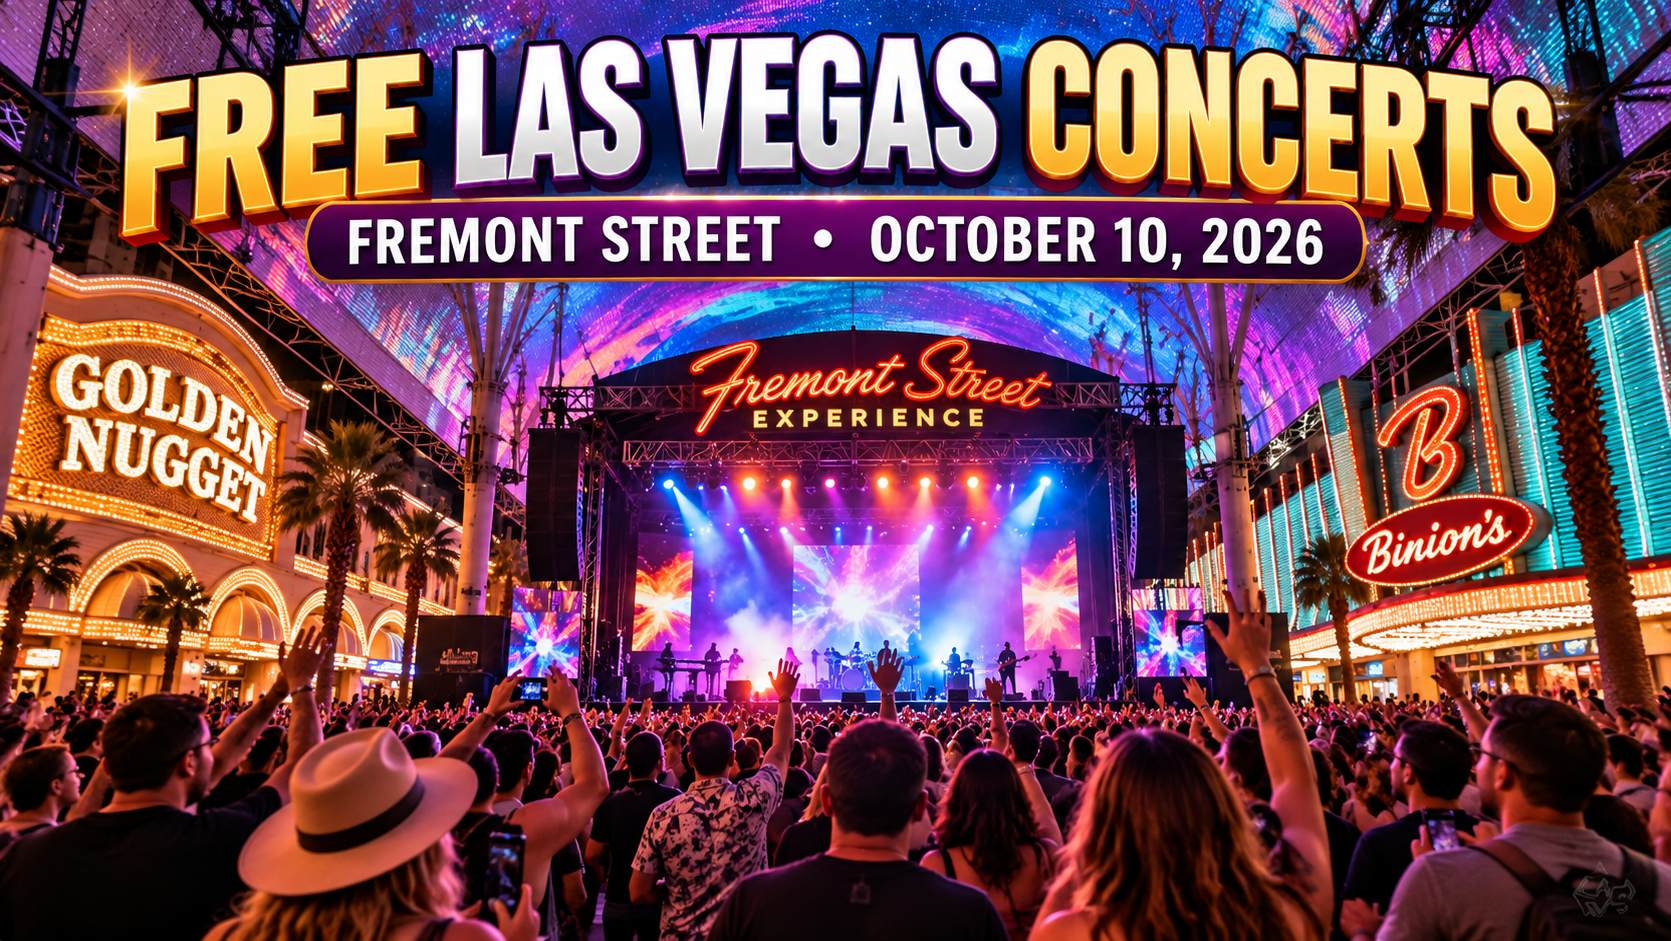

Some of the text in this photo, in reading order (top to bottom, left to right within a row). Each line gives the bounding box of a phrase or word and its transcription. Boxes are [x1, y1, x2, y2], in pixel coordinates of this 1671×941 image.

[53, 353, 274, 475] GOLDEN
[690, 337, 1053, 436] Fremont Street
[752, 408, 985, 429] EXPERIENCE
[61, 414, 267, 524] NUGGET
[1377, 385, 1463, 500] B
[1362, 508, 1512, 576] Binion's
